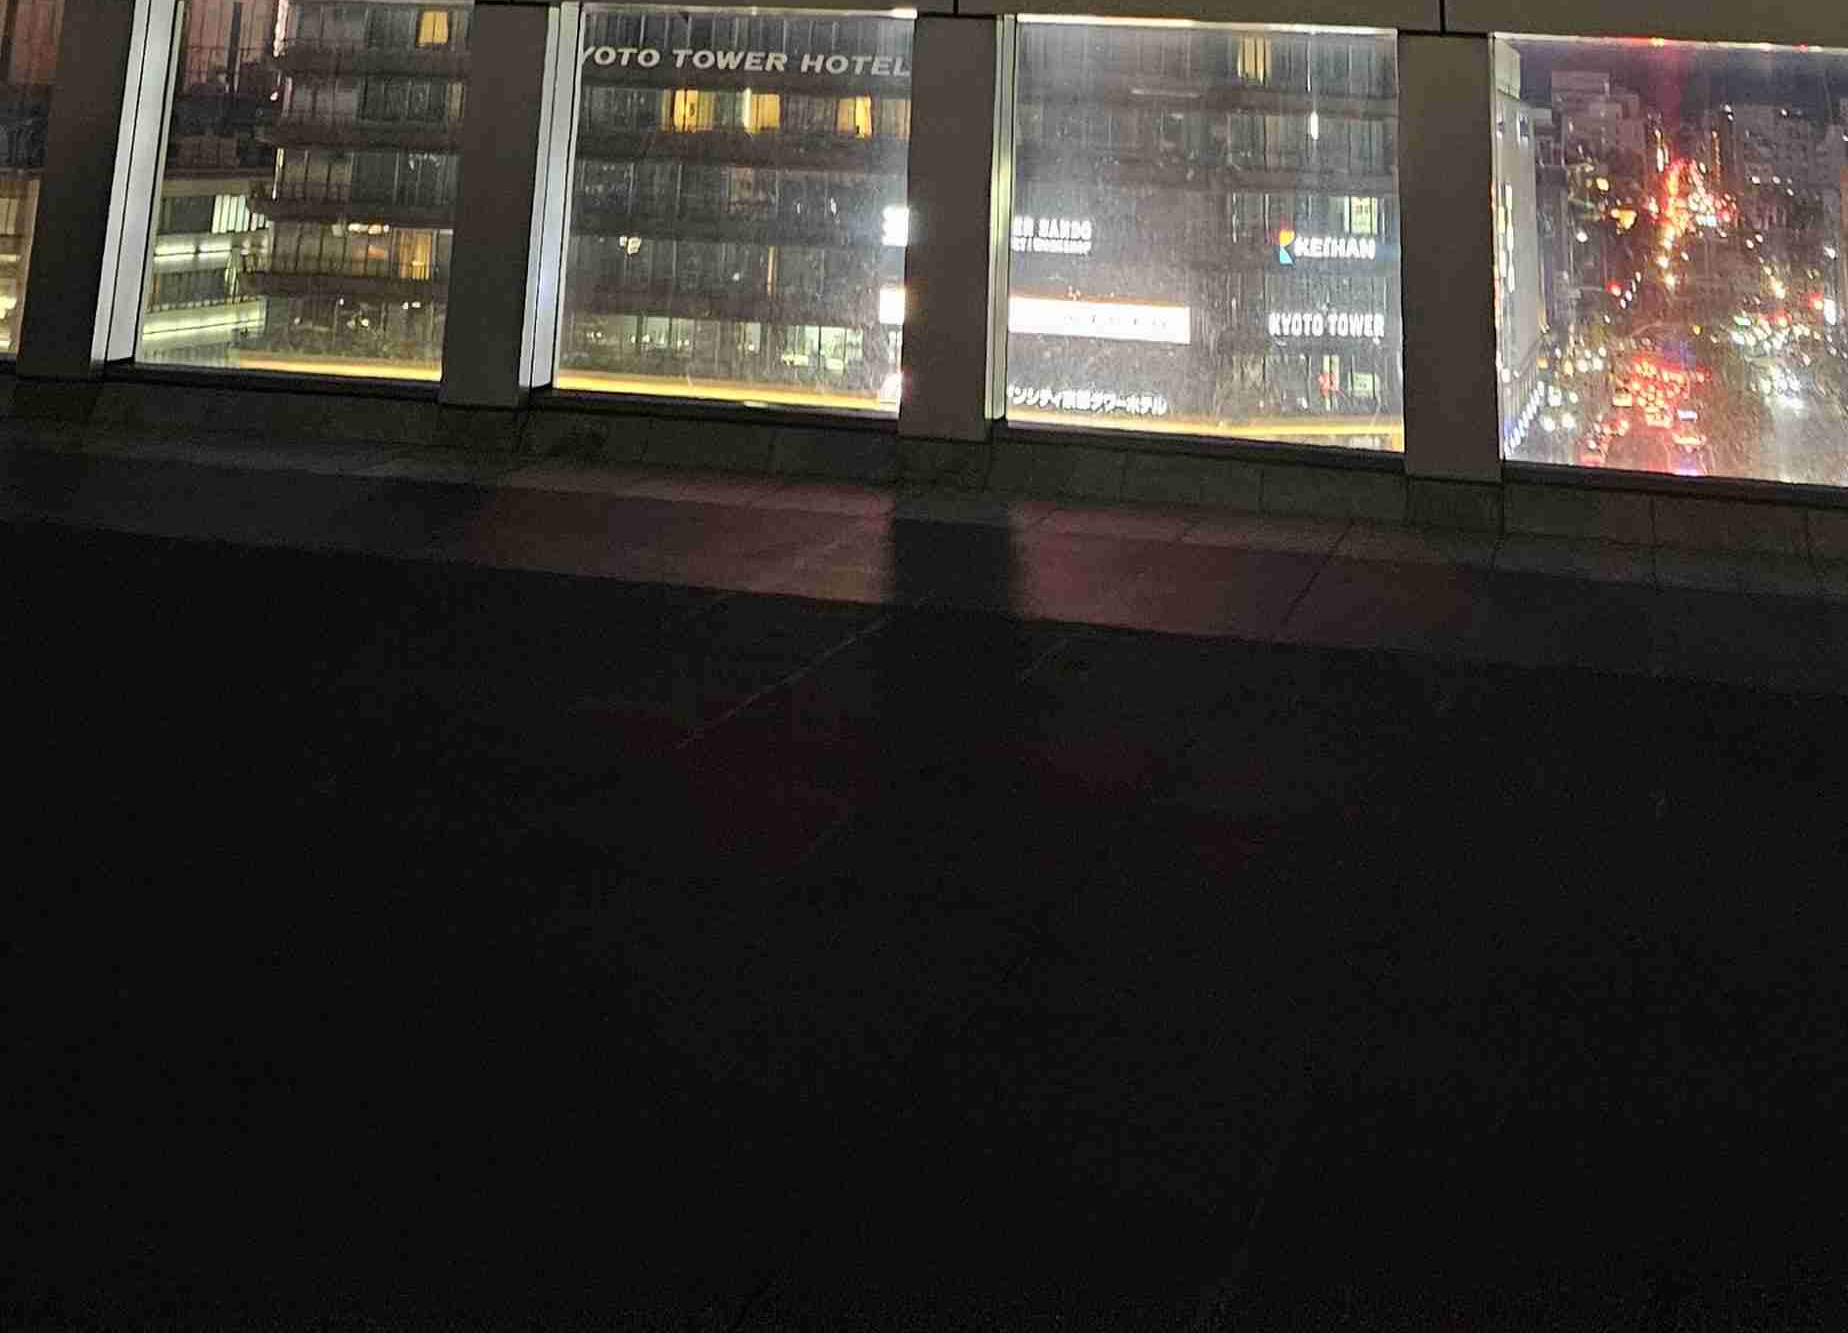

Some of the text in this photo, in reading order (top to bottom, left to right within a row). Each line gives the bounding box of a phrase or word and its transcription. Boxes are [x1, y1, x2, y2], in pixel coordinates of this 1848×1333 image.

[672, 48, 788, 73] TOWER
[801, 53, 911, 78] HOTEL
[1294, 236, 1376, 260] KEIHAN
[1268, 312, 1385, 338] KYOTO TOWER
